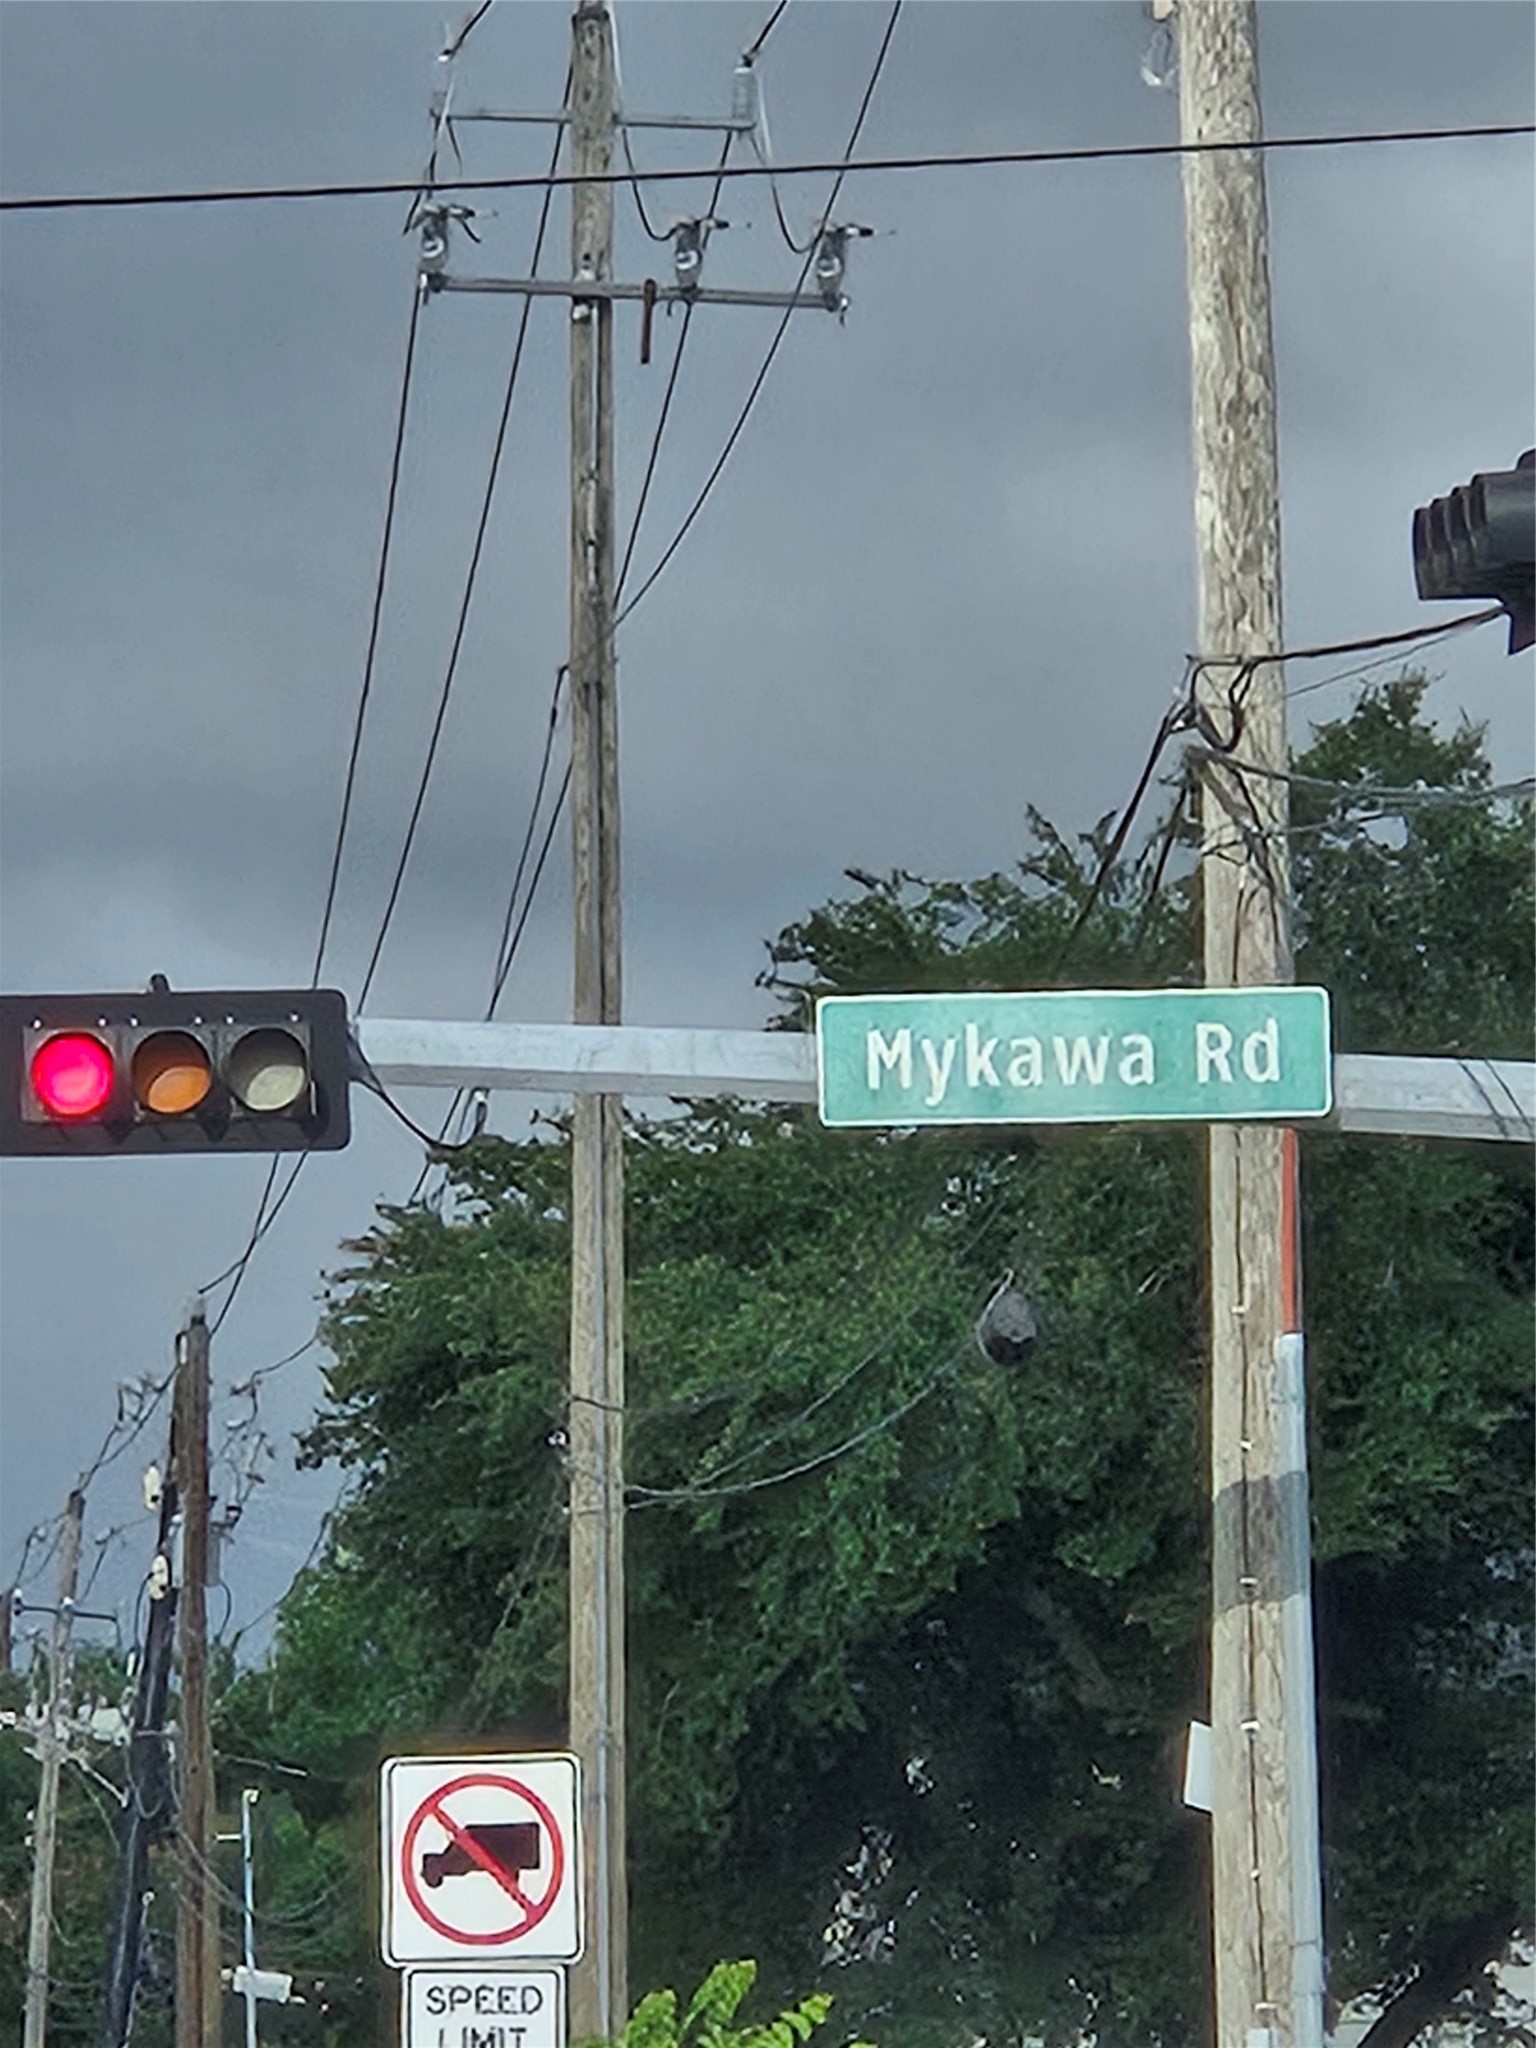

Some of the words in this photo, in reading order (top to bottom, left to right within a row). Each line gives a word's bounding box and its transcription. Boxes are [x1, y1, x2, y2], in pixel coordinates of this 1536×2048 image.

[866, 1022, 1155, 1106] Mykawa
[1196, 1017, 1281, 1085] Rd
[426, 1984, 544, 2015] SPEED
